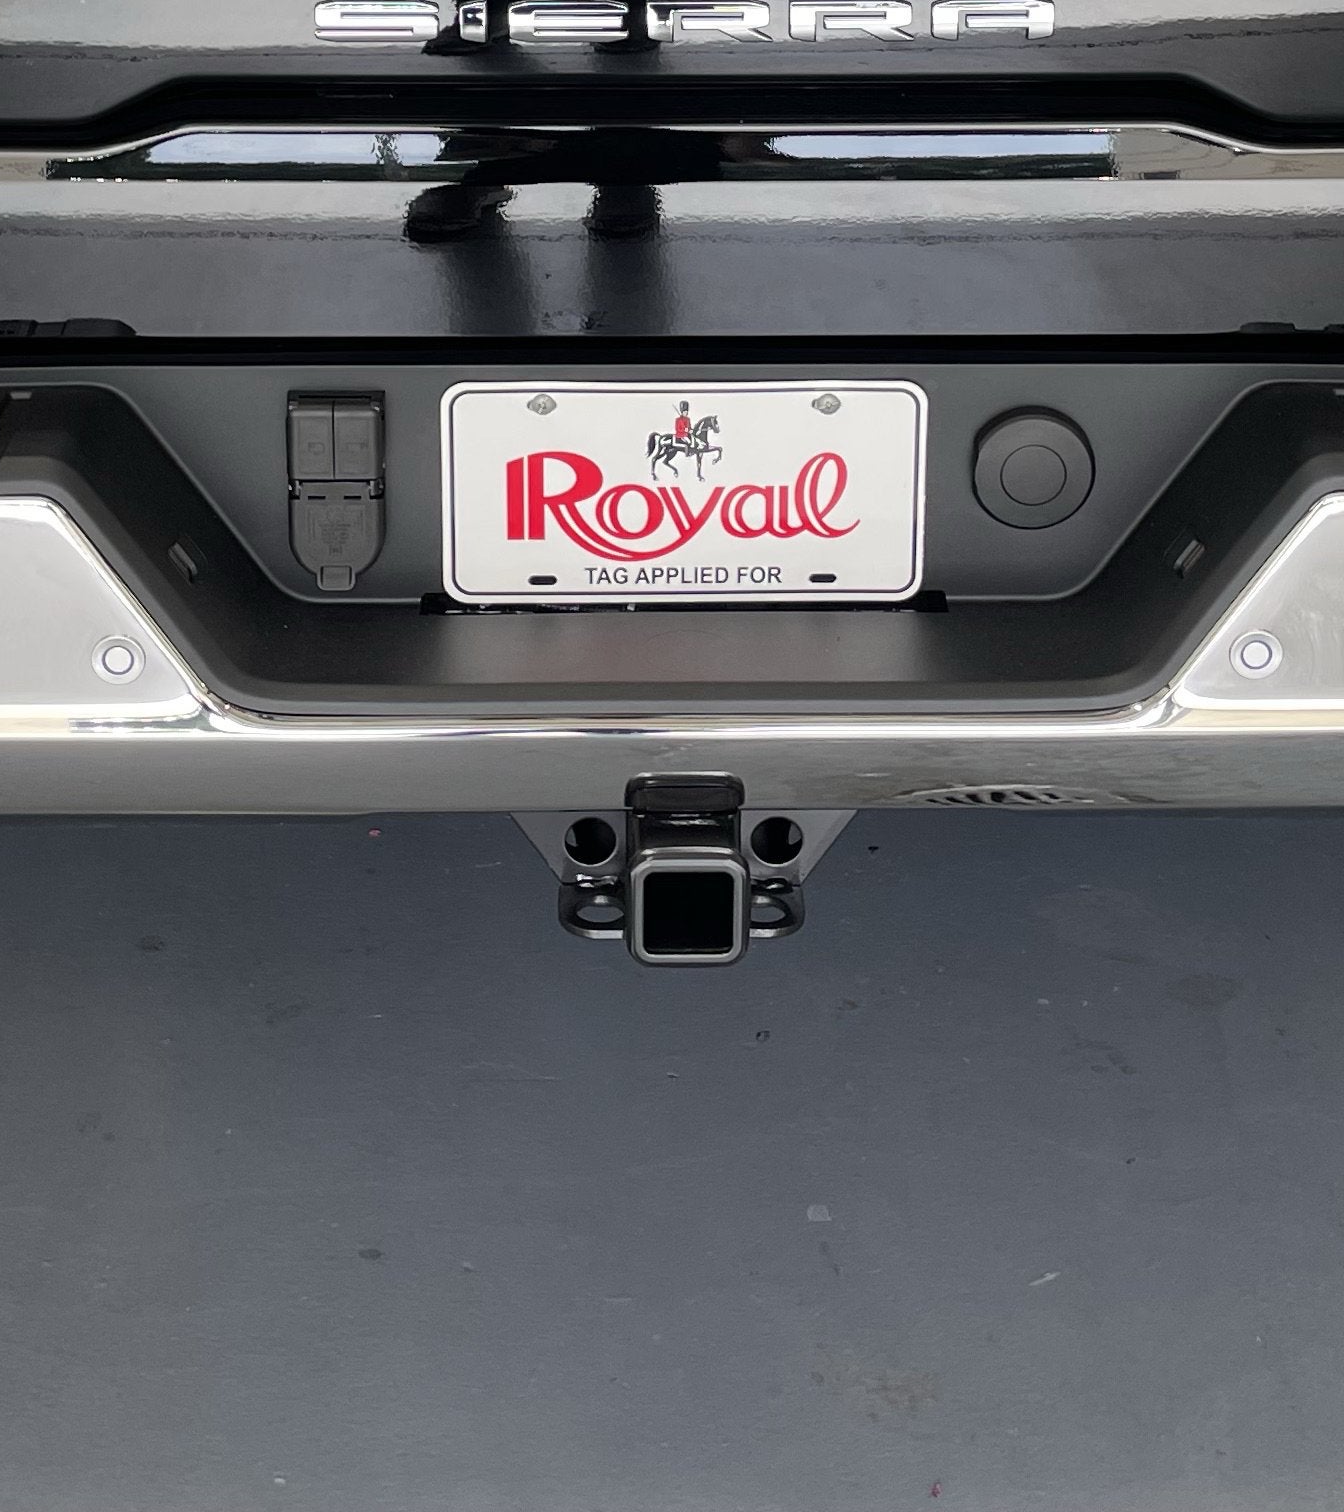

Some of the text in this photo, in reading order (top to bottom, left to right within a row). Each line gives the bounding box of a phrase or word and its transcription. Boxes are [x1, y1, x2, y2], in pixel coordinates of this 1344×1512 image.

[505, 451, 861, 561] Royal
[584, 566, 783, 585] TAG APPLIED FOR
